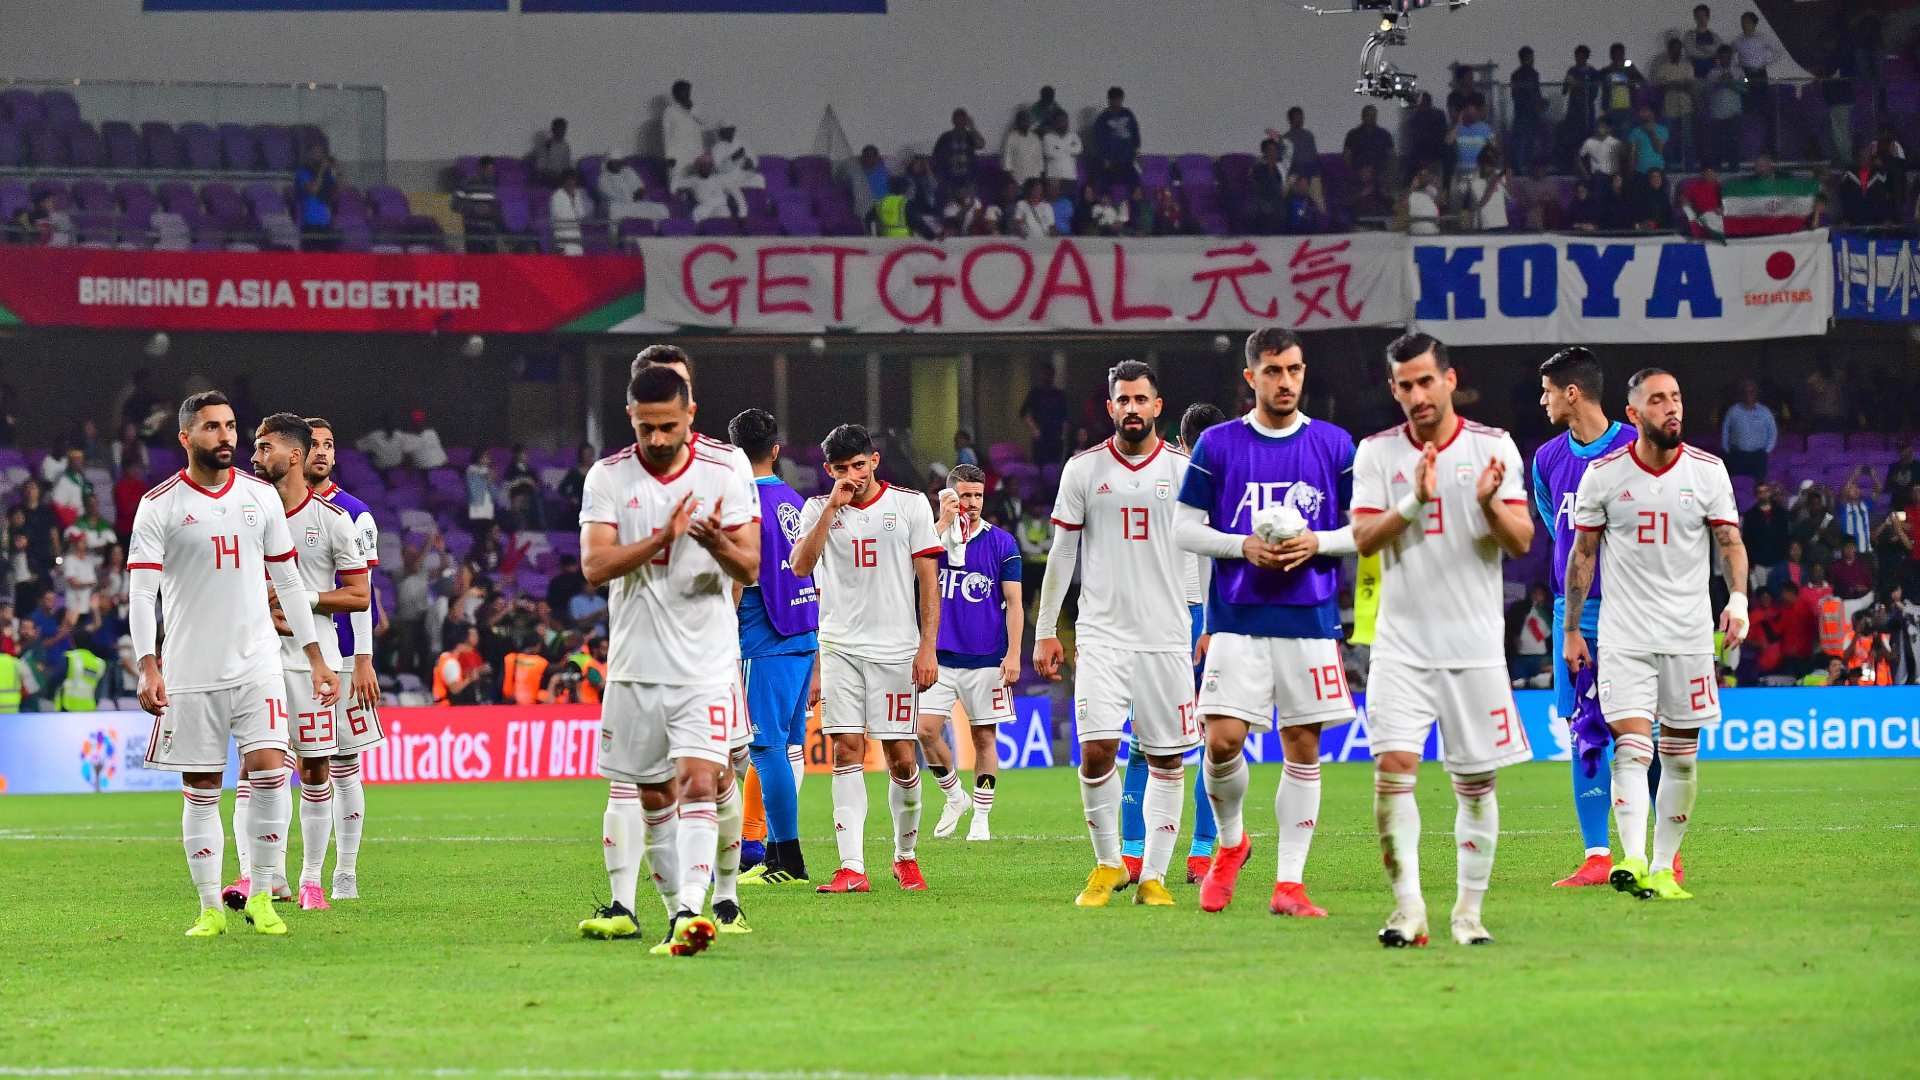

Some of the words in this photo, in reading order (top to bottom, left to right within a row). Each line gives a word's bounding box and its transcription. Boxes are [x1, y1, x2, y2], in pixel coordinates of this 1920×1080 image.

[79, 276, 209, 307] BRINGING
[215, 278, 296, 308] ASIA
[301, 279, 480, 310] TOGETHER
[1187, 239, 1364, 327] 元気
[1414, 243, 1723, 320] KOYA
[1120, 507, 1149, 541] 13
[1637, 511, 1668, 545] 21
[211, 535, 240, 569] 14
[851, 538, 877, 567] 16
[938, 568, 995, 603] AFC
[1309, 664, 1343, 701] 19
[345, 705, 369, 736] 6
[708, 705, 727, 742] 9
[885, 693, 911, 722] 16
[298, 711, 333, 742] 23
[1489, 707, 1510, 746] 3
[361, 721, 491, 780] mirates
[503, 720, 545, 777] FLY
[548, 719, 603, 776] BETT
